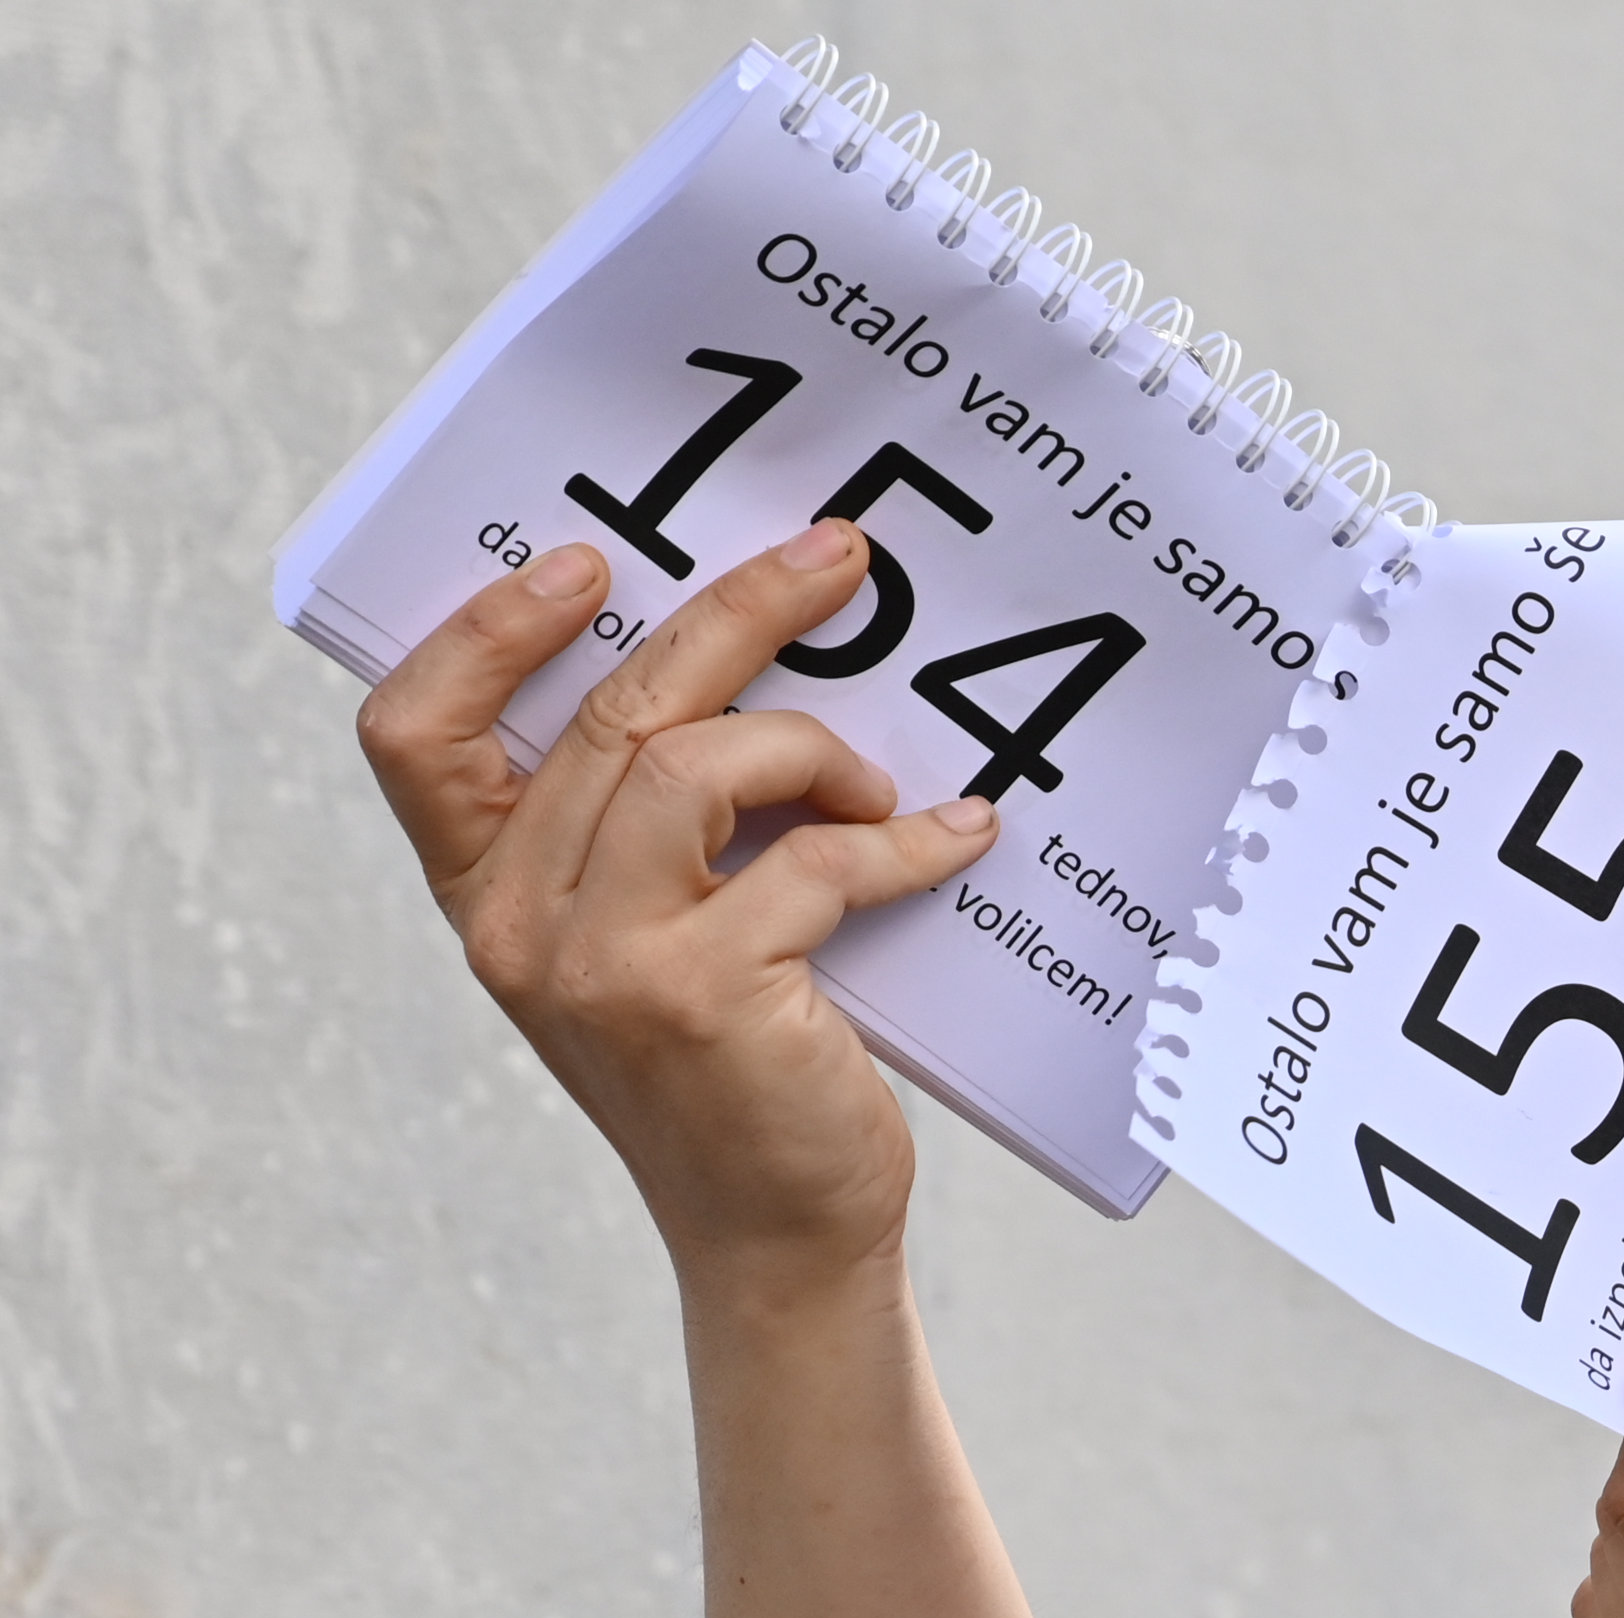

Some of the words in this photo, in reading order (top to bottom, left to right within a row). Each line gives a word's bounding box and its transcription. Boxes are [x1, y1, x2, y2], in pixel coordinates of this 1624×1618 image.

[755, 231, 951, 382] Ostalo
[960, 370, 1088, 488] vam
[1072, 472, 1153, 542] je
[1153, 537, 1316, 670] samo
[478, 521, 532, 570] da
[564, 347, 1147, 804] 154
[1038, 833, 1177, 960] tednov,
[1241, 990, 1331, 1166] Ostalo
[1311, 845, 1409, 975] vam
[1377, 771, 1450, 850] je
[1434, 591, 1556, 764] samo
[1524, 527, 1606, 583] še
[954, 882, 1133, 1026] volilcem!
[1578, 1346, 1615, 1393] da
